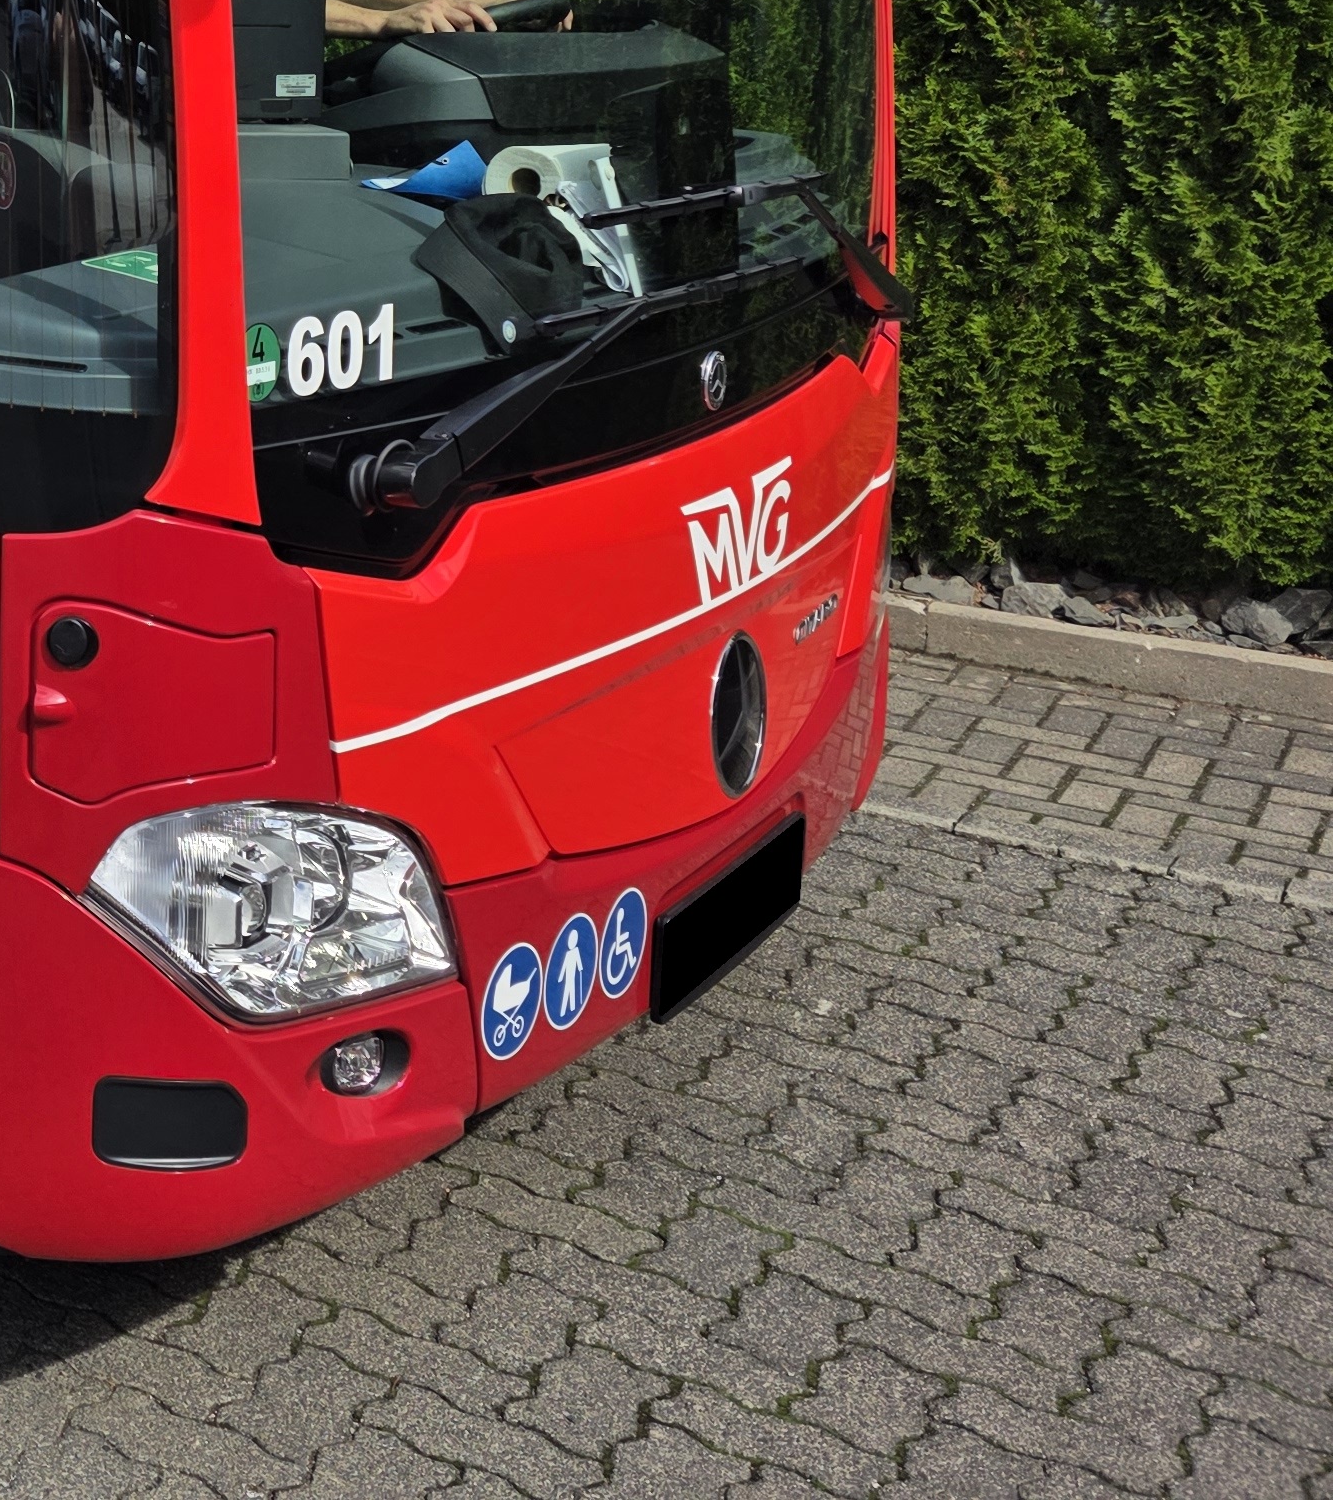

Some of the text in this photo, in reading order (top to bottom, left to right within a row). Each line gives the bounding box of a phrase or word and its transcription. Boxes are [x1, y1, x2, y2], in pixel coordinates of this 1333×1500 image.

[252, 327, 265, 362] 4
[288, 303, 394, 397] 601
[680, 455, 793, 605] MVG
